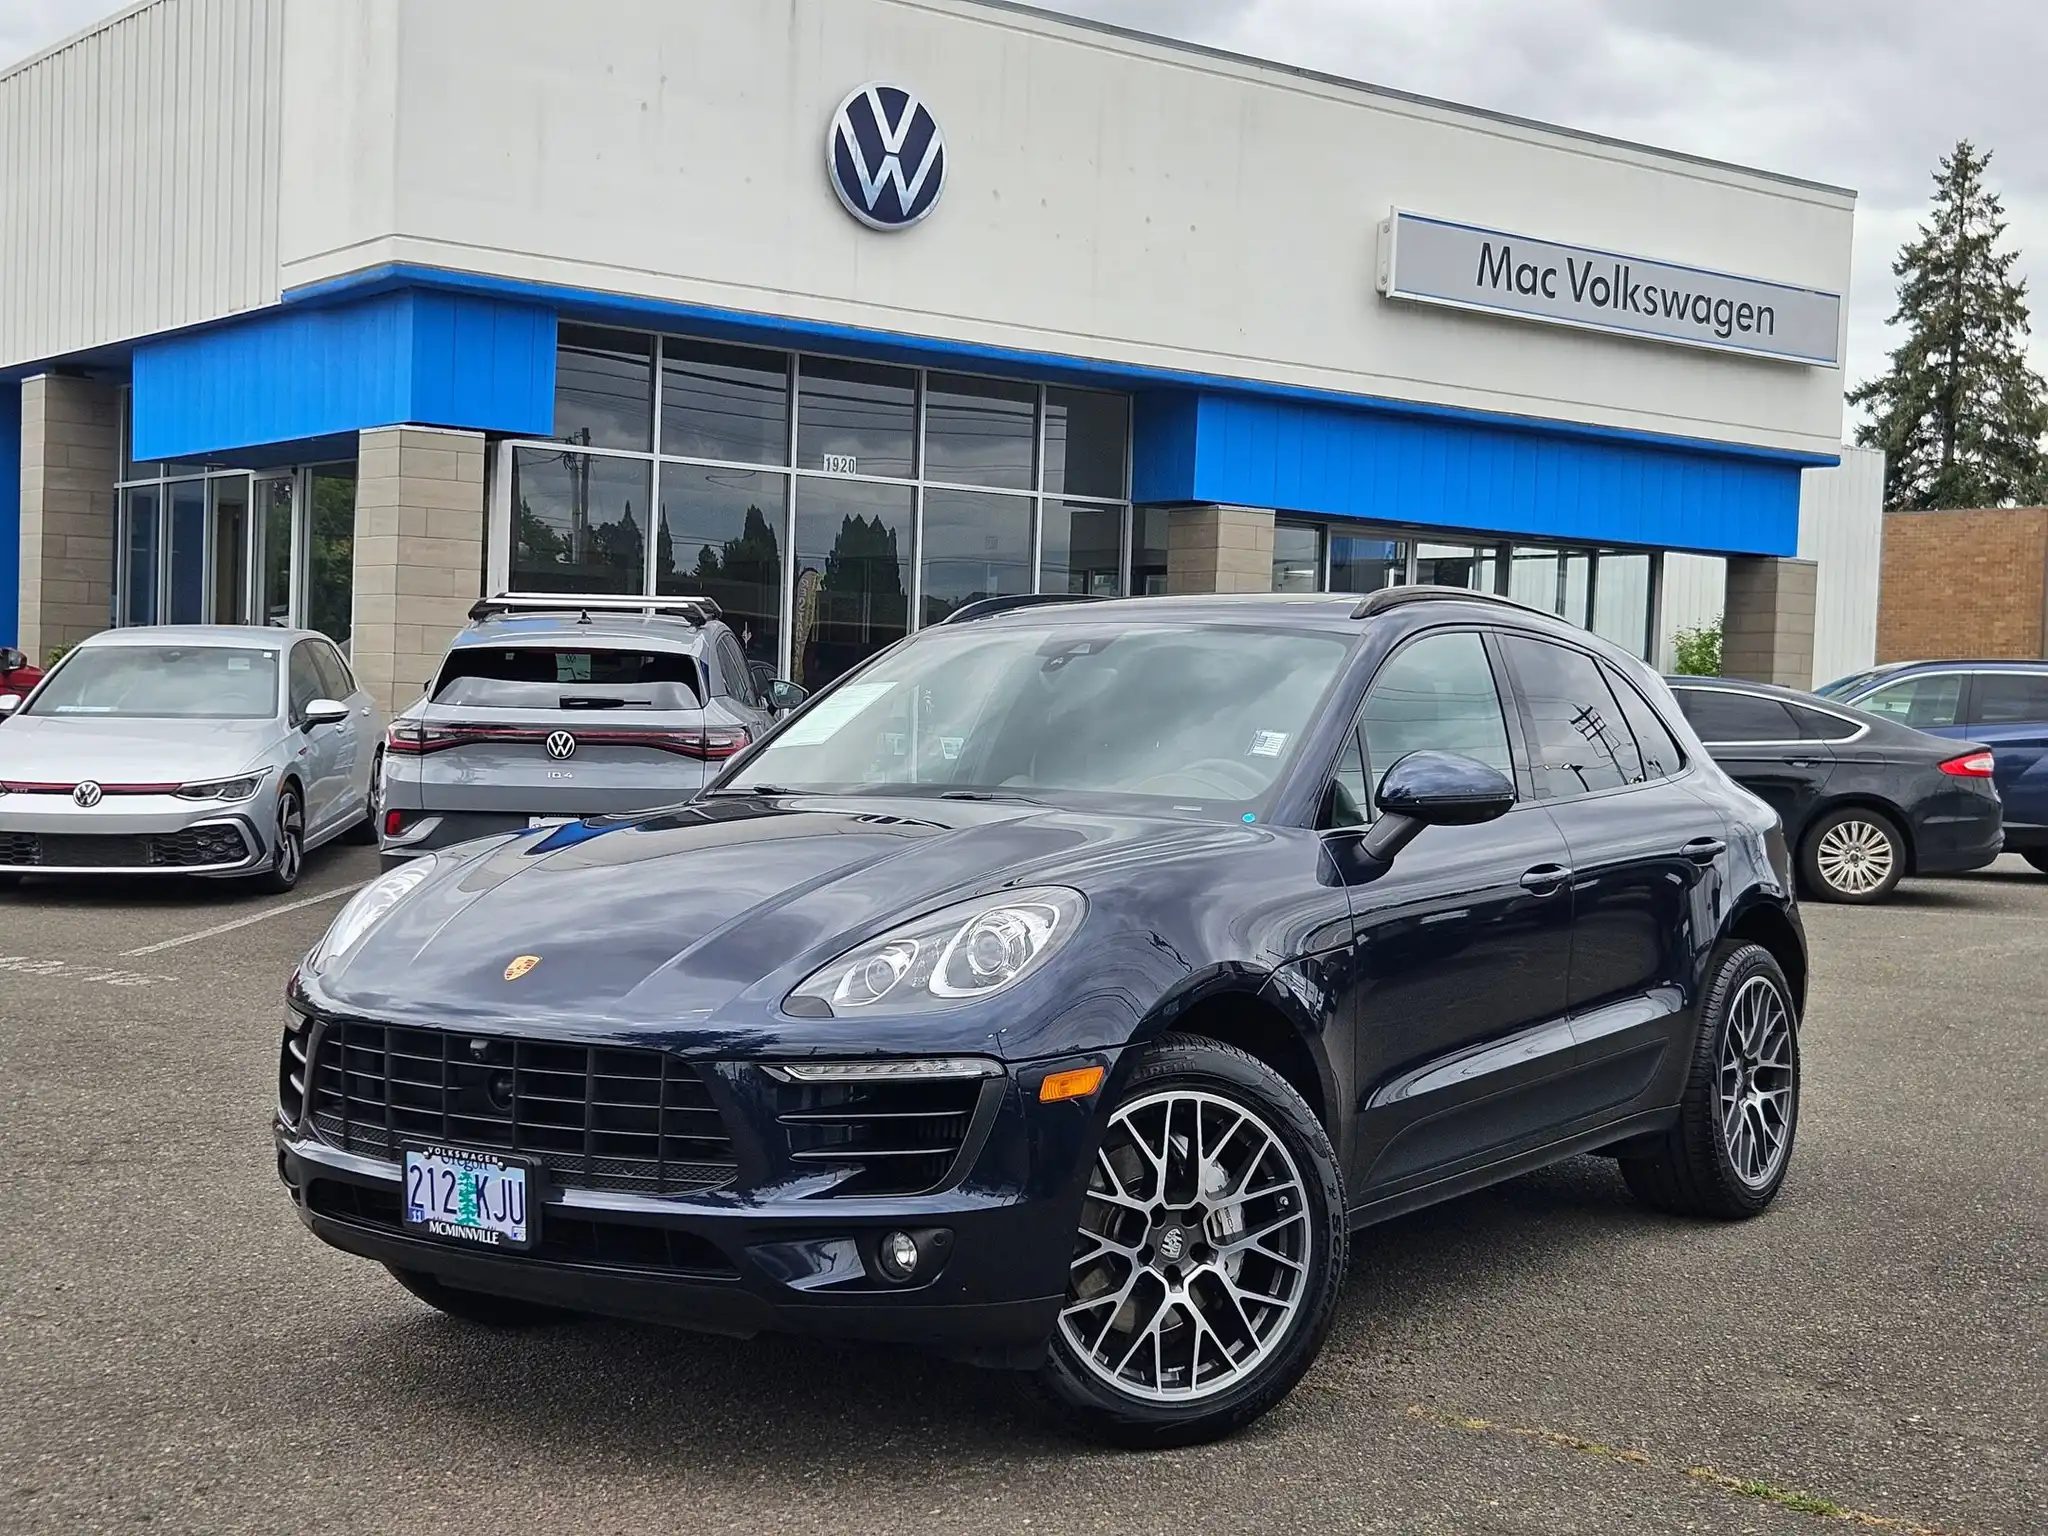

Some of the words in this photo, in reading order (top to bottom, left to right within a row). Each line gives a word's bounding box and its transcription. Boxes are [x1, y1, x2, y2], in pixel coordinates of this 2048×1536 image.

[1476, 242, 1557, 299] Mac
[1565, 256, 1774, 339] Volkswagen
[825, 456, 855, 474] 1920
[428, 1147, 498, 1163] VOLKSWAGEN
[410, 1164, 458, 1215] 212
[475, 1174, 524, 1225] KJU
[428, 1220, 500, 1245] MCMINNVILLE
